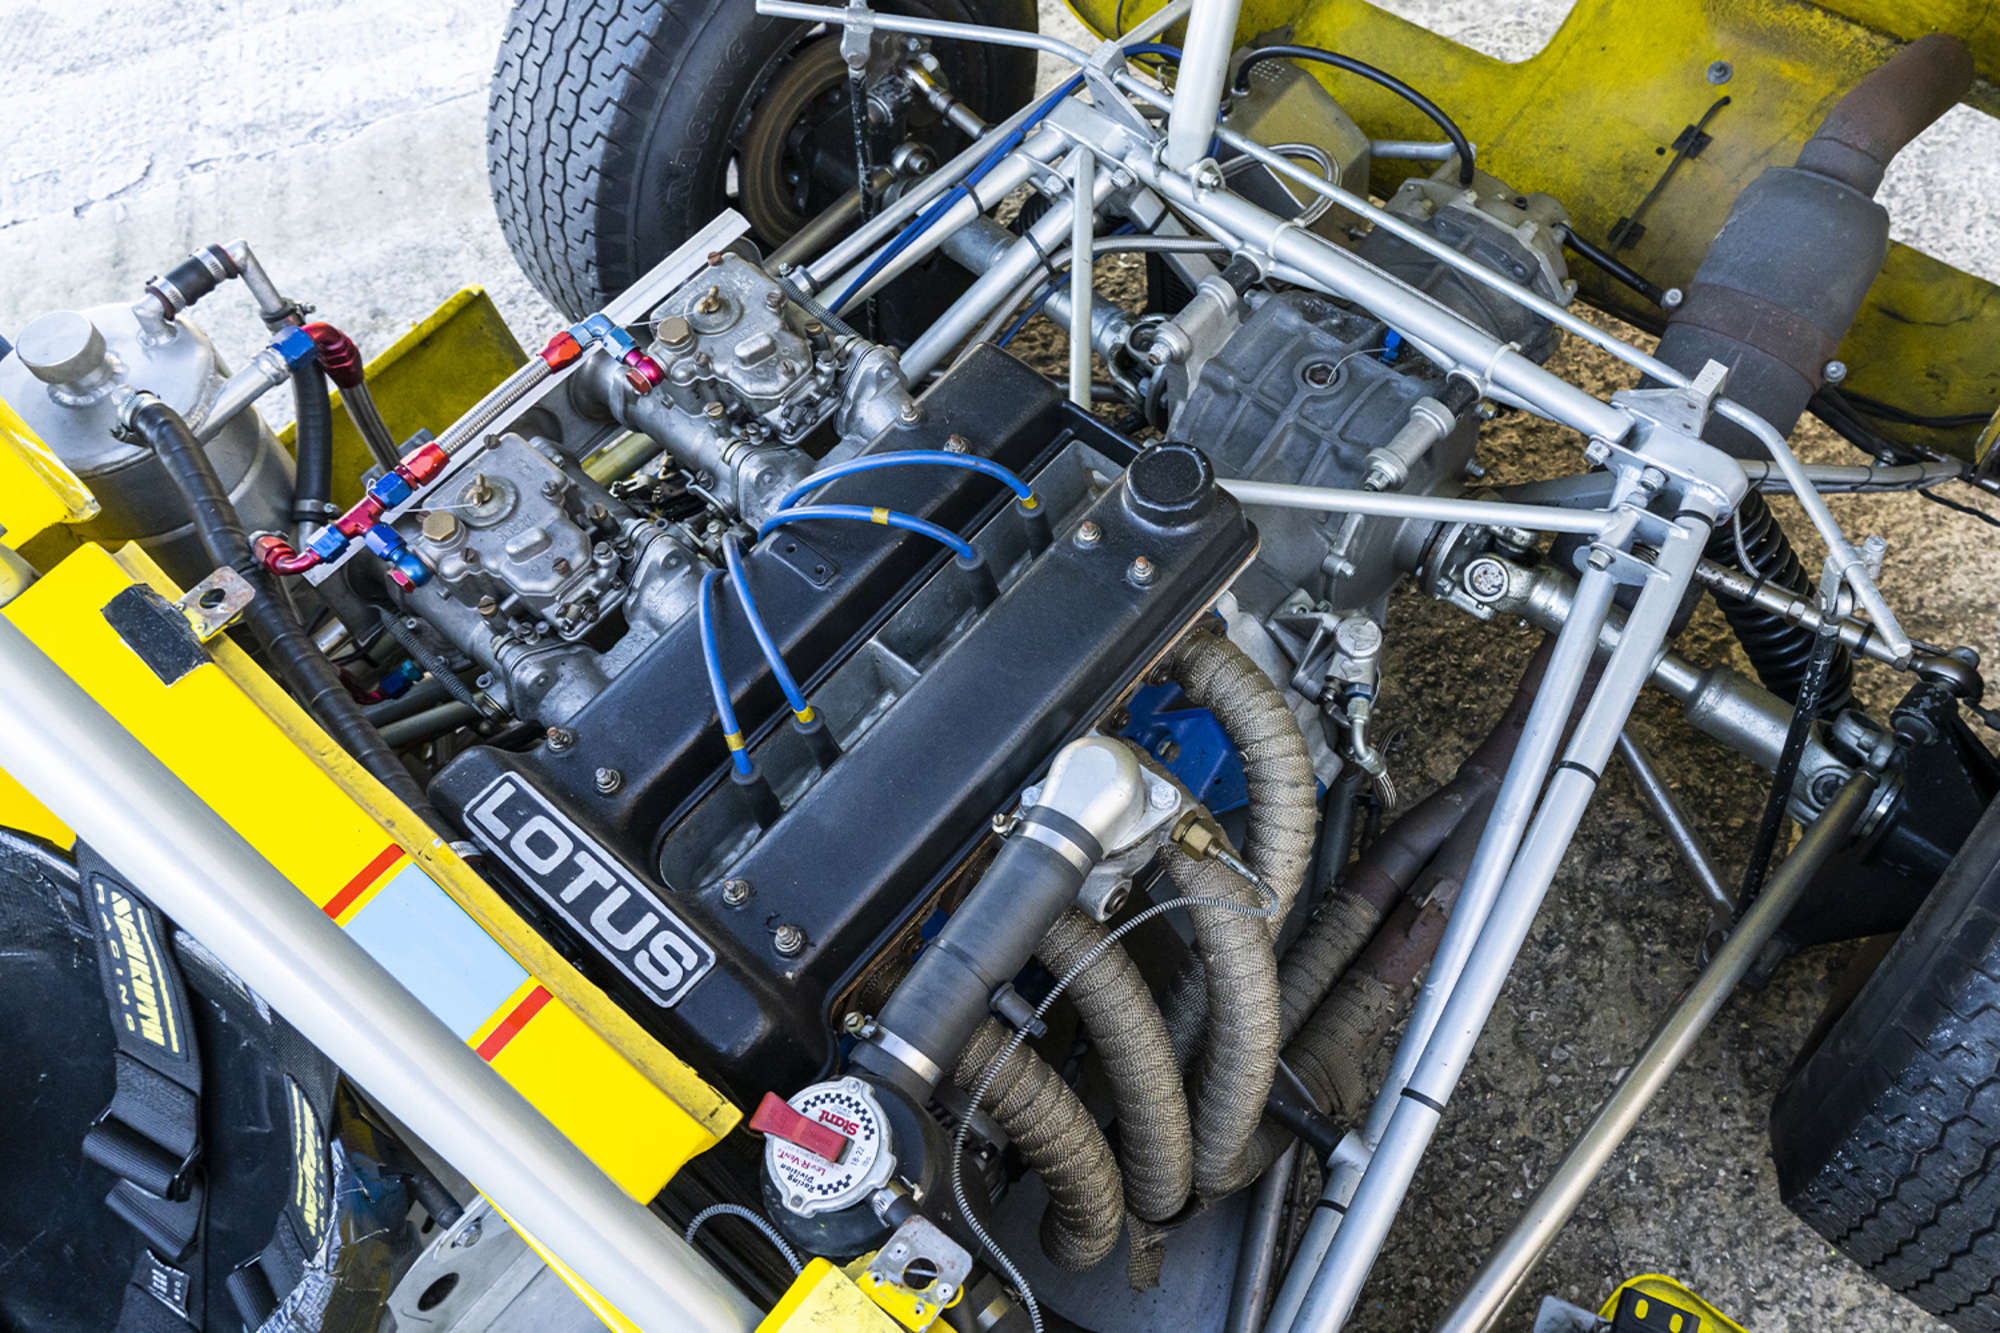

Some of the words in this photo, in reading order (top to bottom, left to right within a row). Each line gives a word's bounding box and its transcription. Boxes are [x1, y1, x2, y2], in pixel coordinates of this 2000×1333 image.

[473, 781, 699, 992] LOTUS
[818, 1109, 859, 1136] Stant
[780, 1162, 814, 1184] Division
[787, 1174, 815, 1193] Racing
